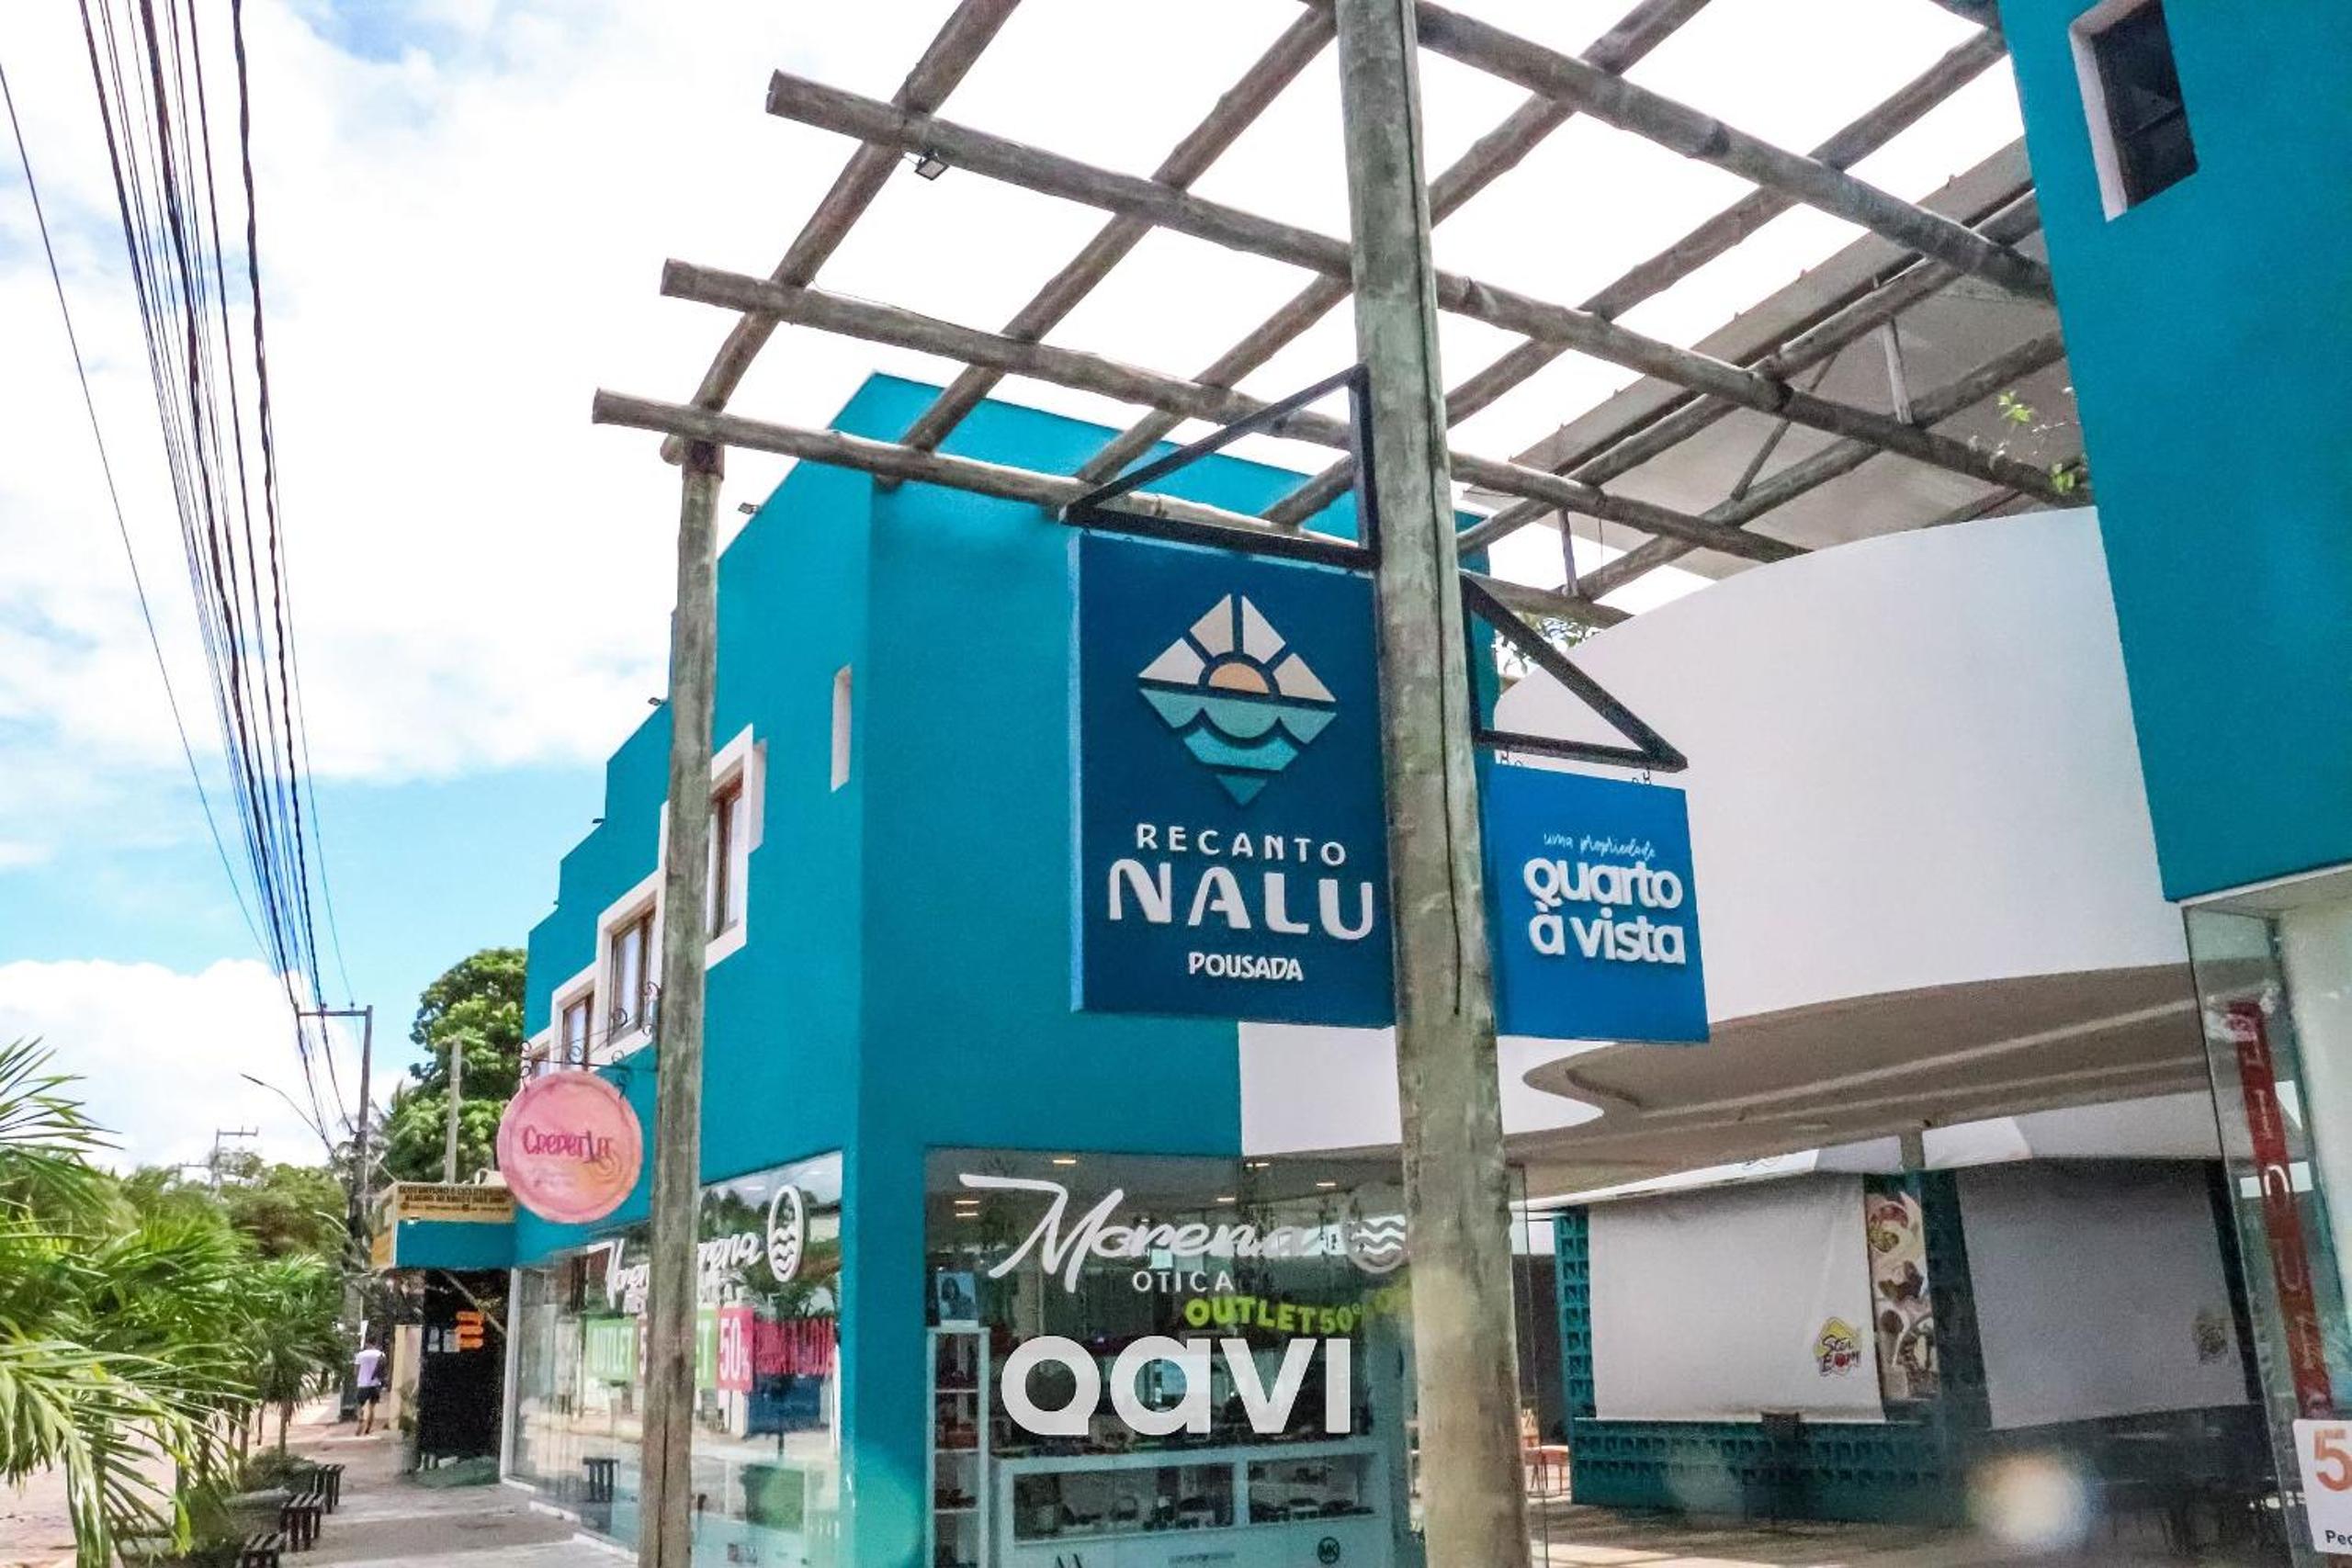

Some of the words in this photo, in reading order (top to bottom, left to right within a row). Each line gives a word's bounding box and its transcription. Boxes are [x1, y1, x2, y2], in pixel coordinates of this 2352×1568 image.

[1136, 822, 1347, 866] RECANTO
[1544, 833, 1574, 849] uma
[1109, 858, 1374, 941] NALU
[1529, 901, 1566, 956] à
[1569, 907, 1687, 964] vista
[1188, 952, 1305, 982] POUSADA
[959, 1173, 1327, 1293] Morena
